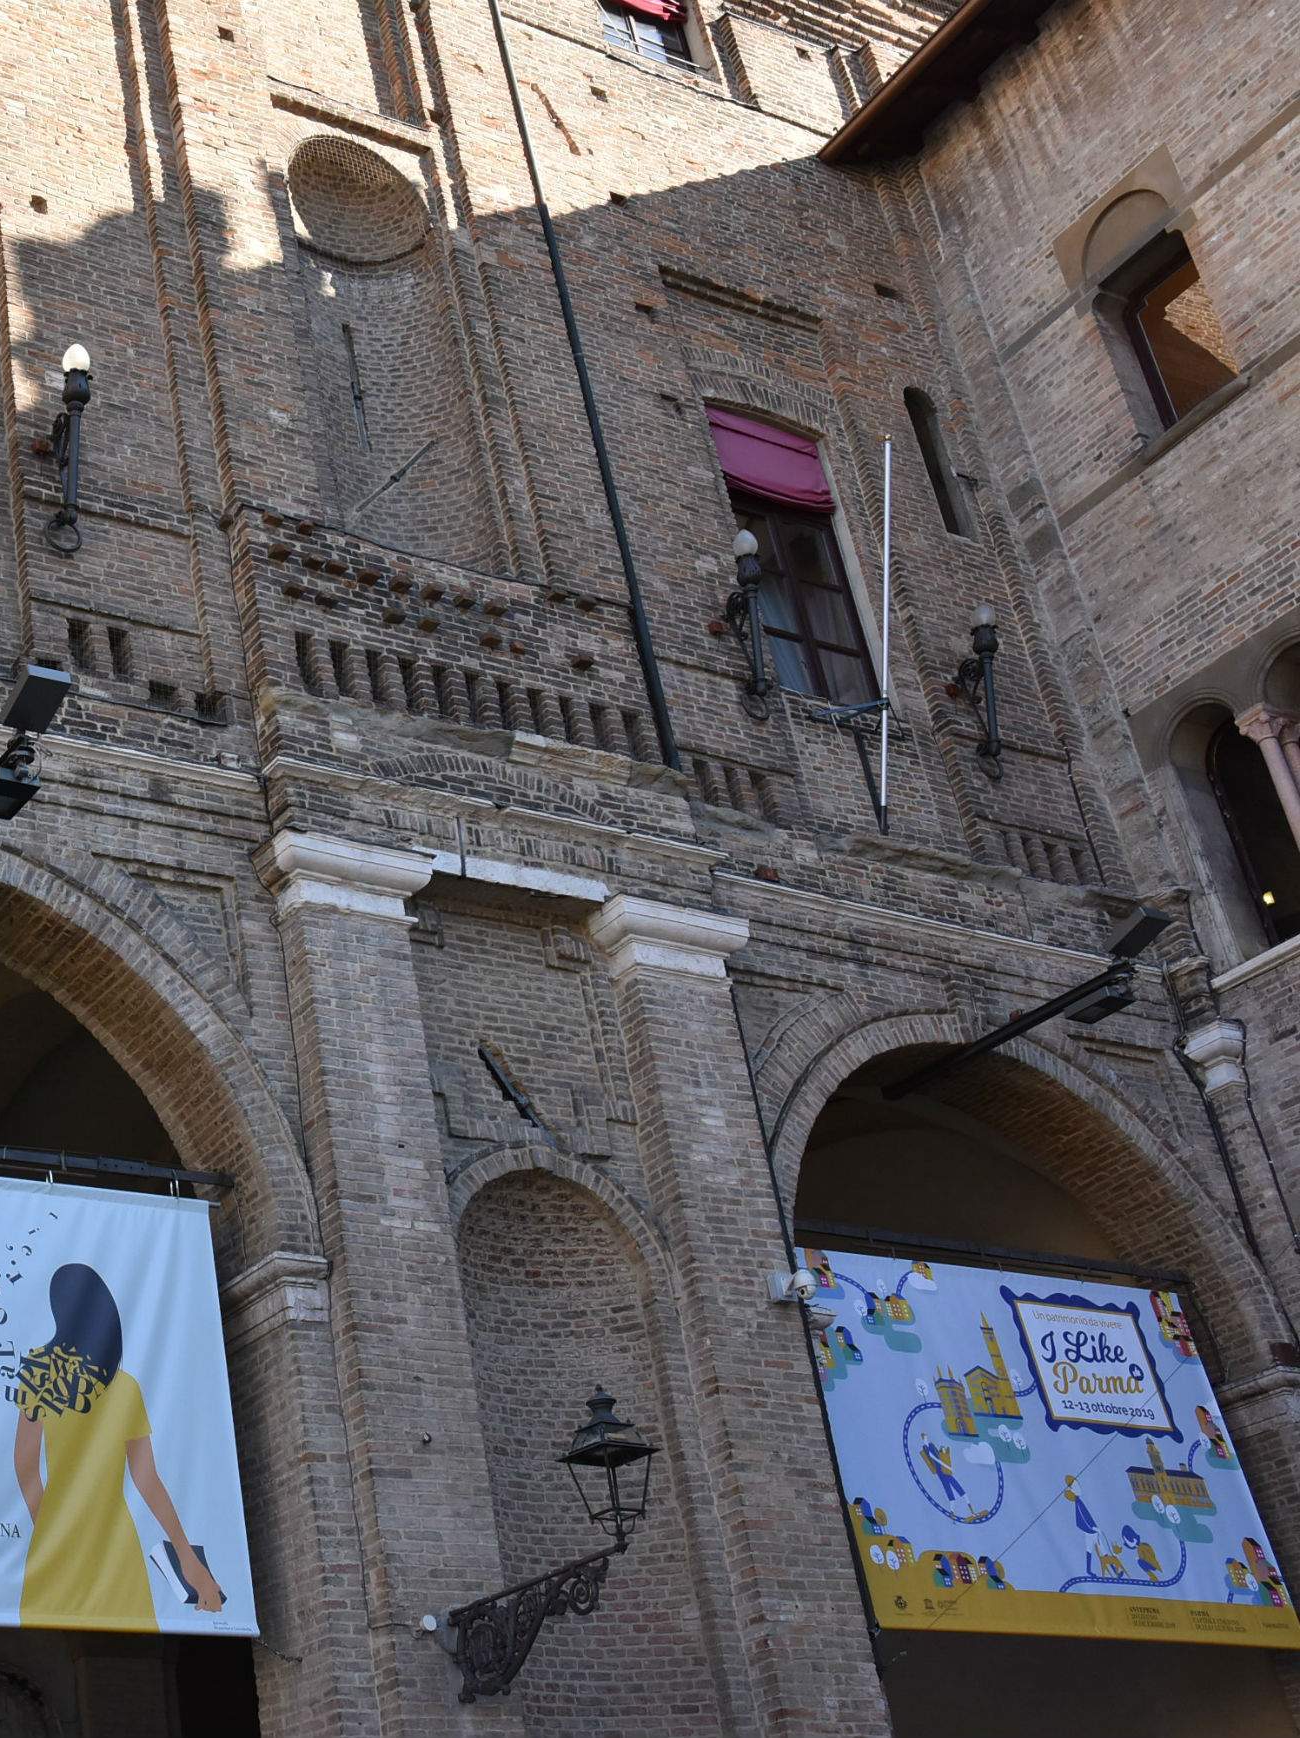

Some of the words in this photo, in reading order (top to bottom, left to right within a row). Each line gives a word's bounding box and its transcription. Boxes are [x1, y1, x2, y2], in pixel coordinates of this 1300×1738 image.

[1040, 1330, 1057, 1363] I
[1062, 1330, 1127, 1363] Like
[1053, 1361, 1144, 1394] Parma
[1062, 1400, 1091, 1414] 12-13
[1091, 1402, 1128, 1416] ottobre
[1129, 1407, 1155, 1420] 2019
